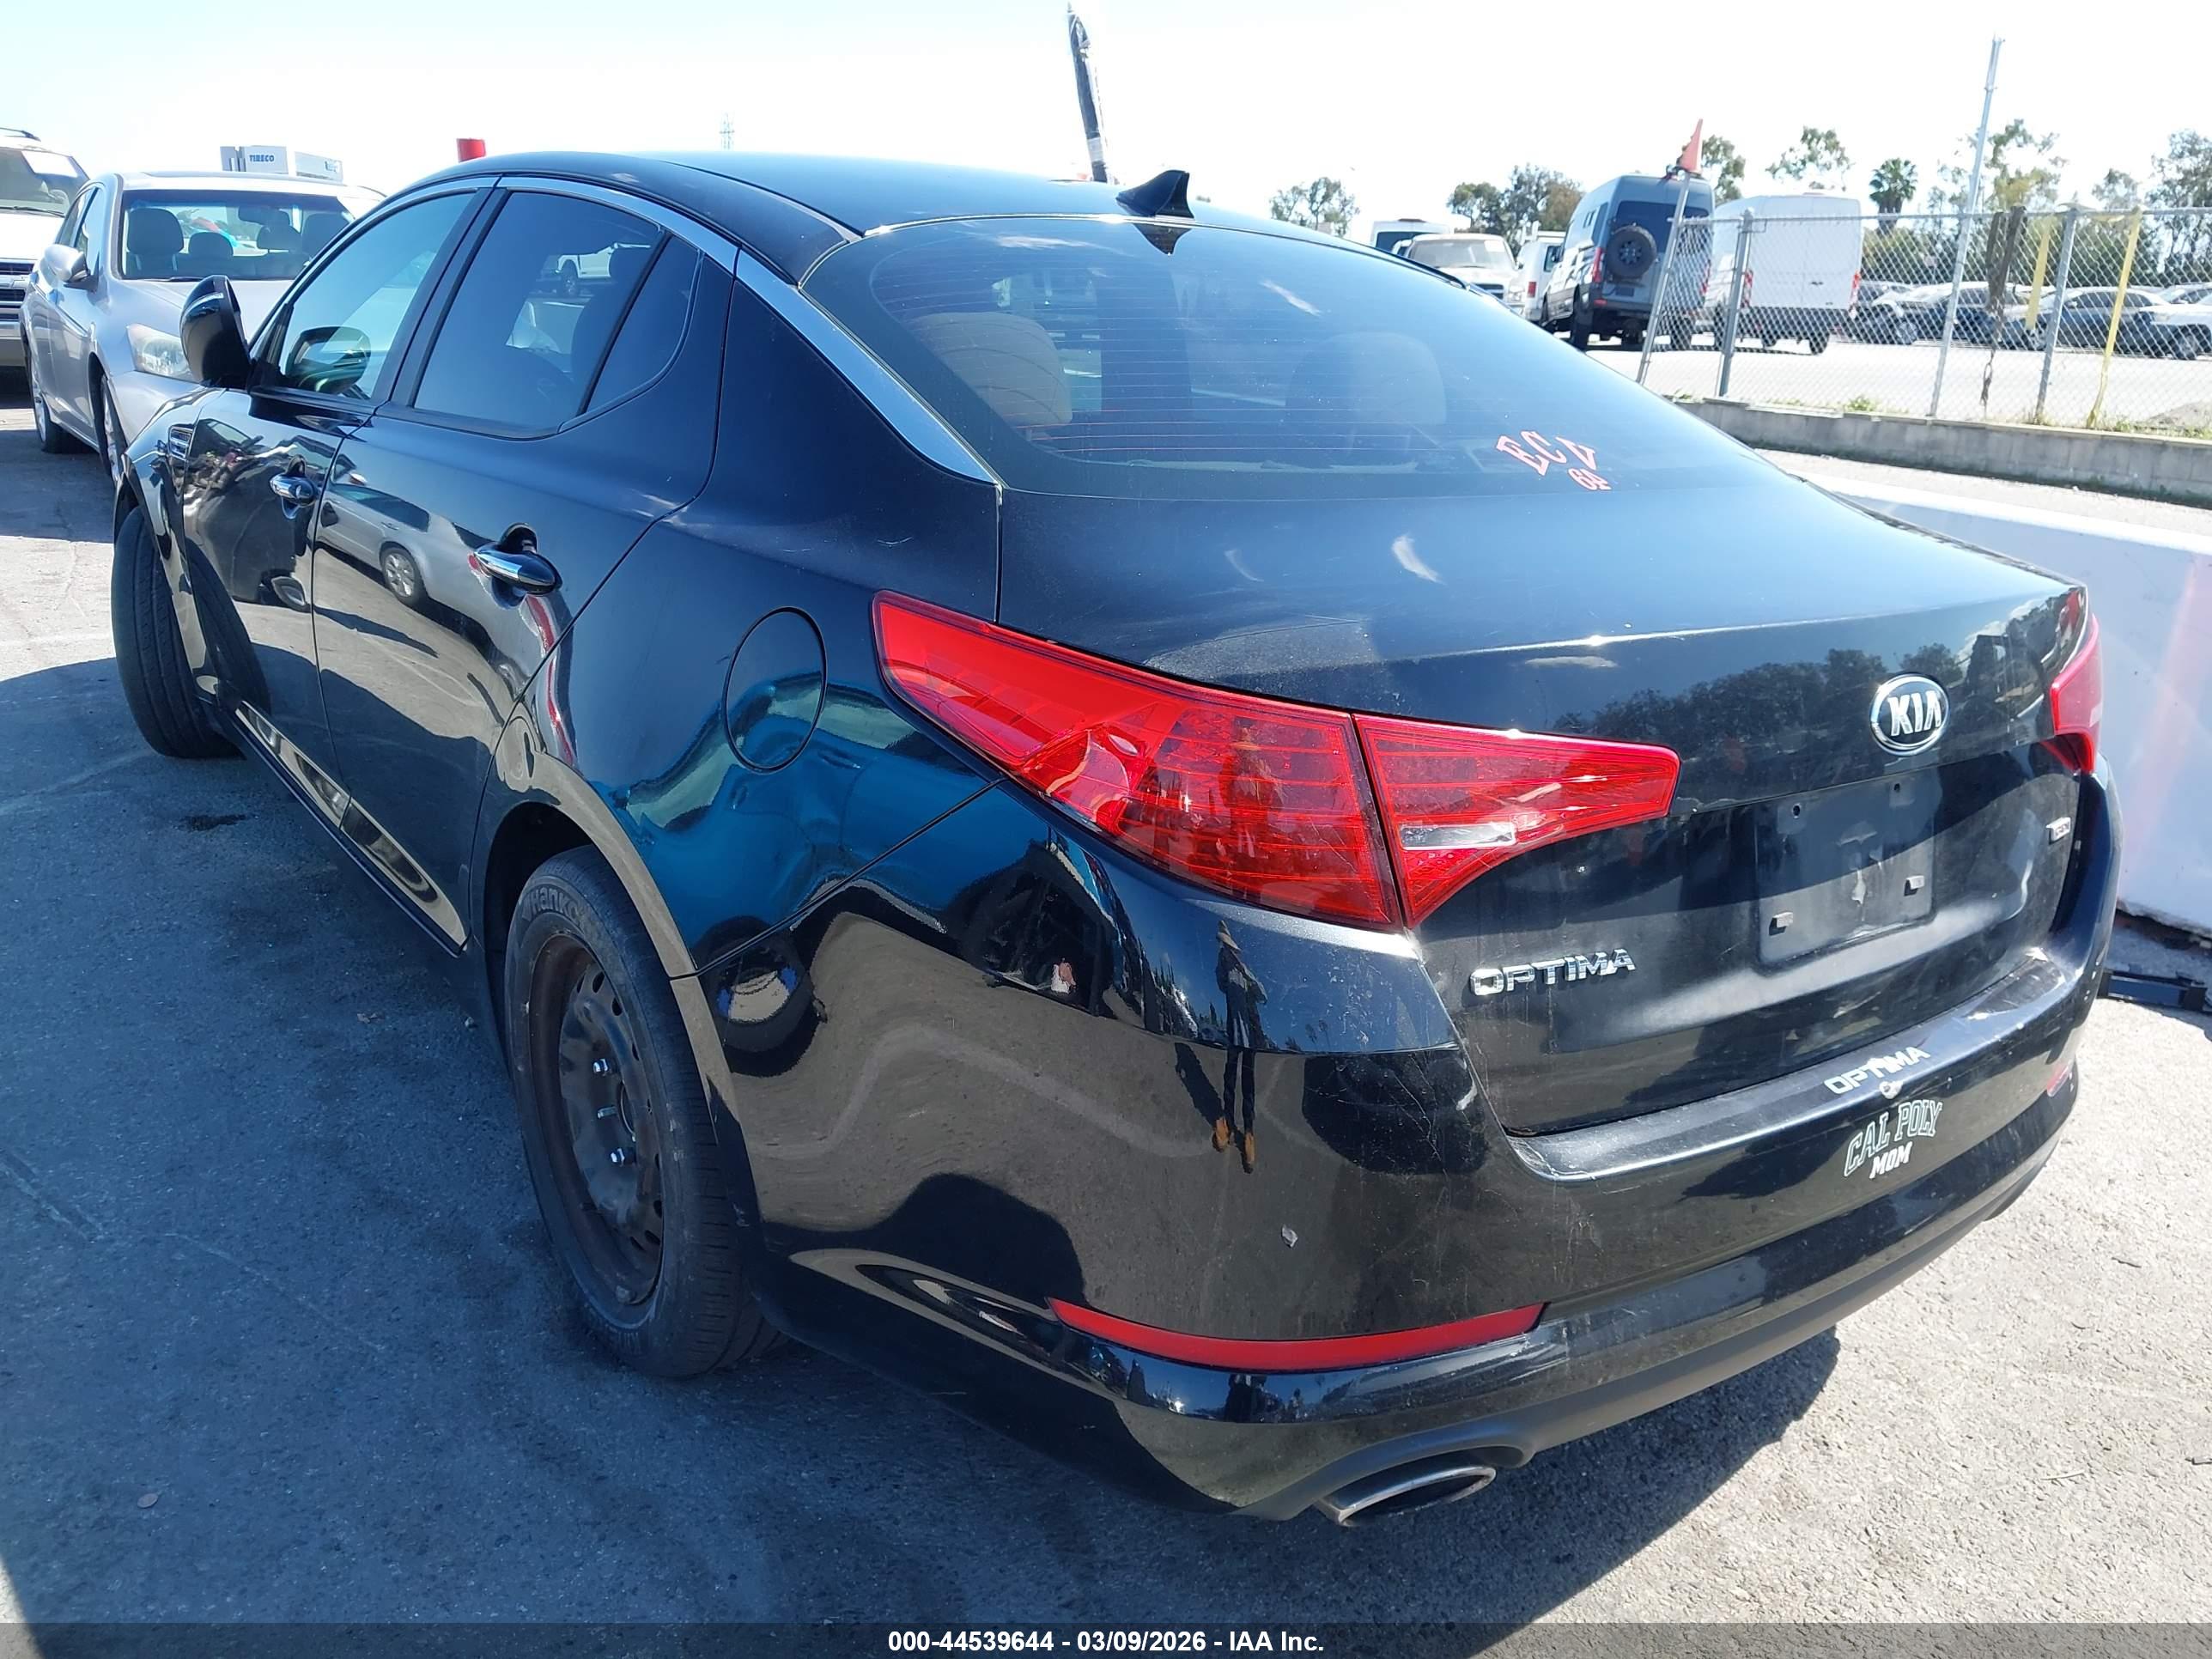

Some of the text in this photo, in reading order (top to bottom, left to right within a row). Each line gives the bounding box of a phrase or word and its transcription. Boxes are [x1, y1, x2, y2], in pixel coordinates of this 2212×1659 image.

[1887, 690, 1942, 737] KIA
[1470, 948, 1636, 996] OPTIMA
[1824, 1047, 1930, 1094] OPTIMA
[1844, 1099, 1943, 1176] CAL POLY
[1869, 1141, 1913, 1179] MOM
